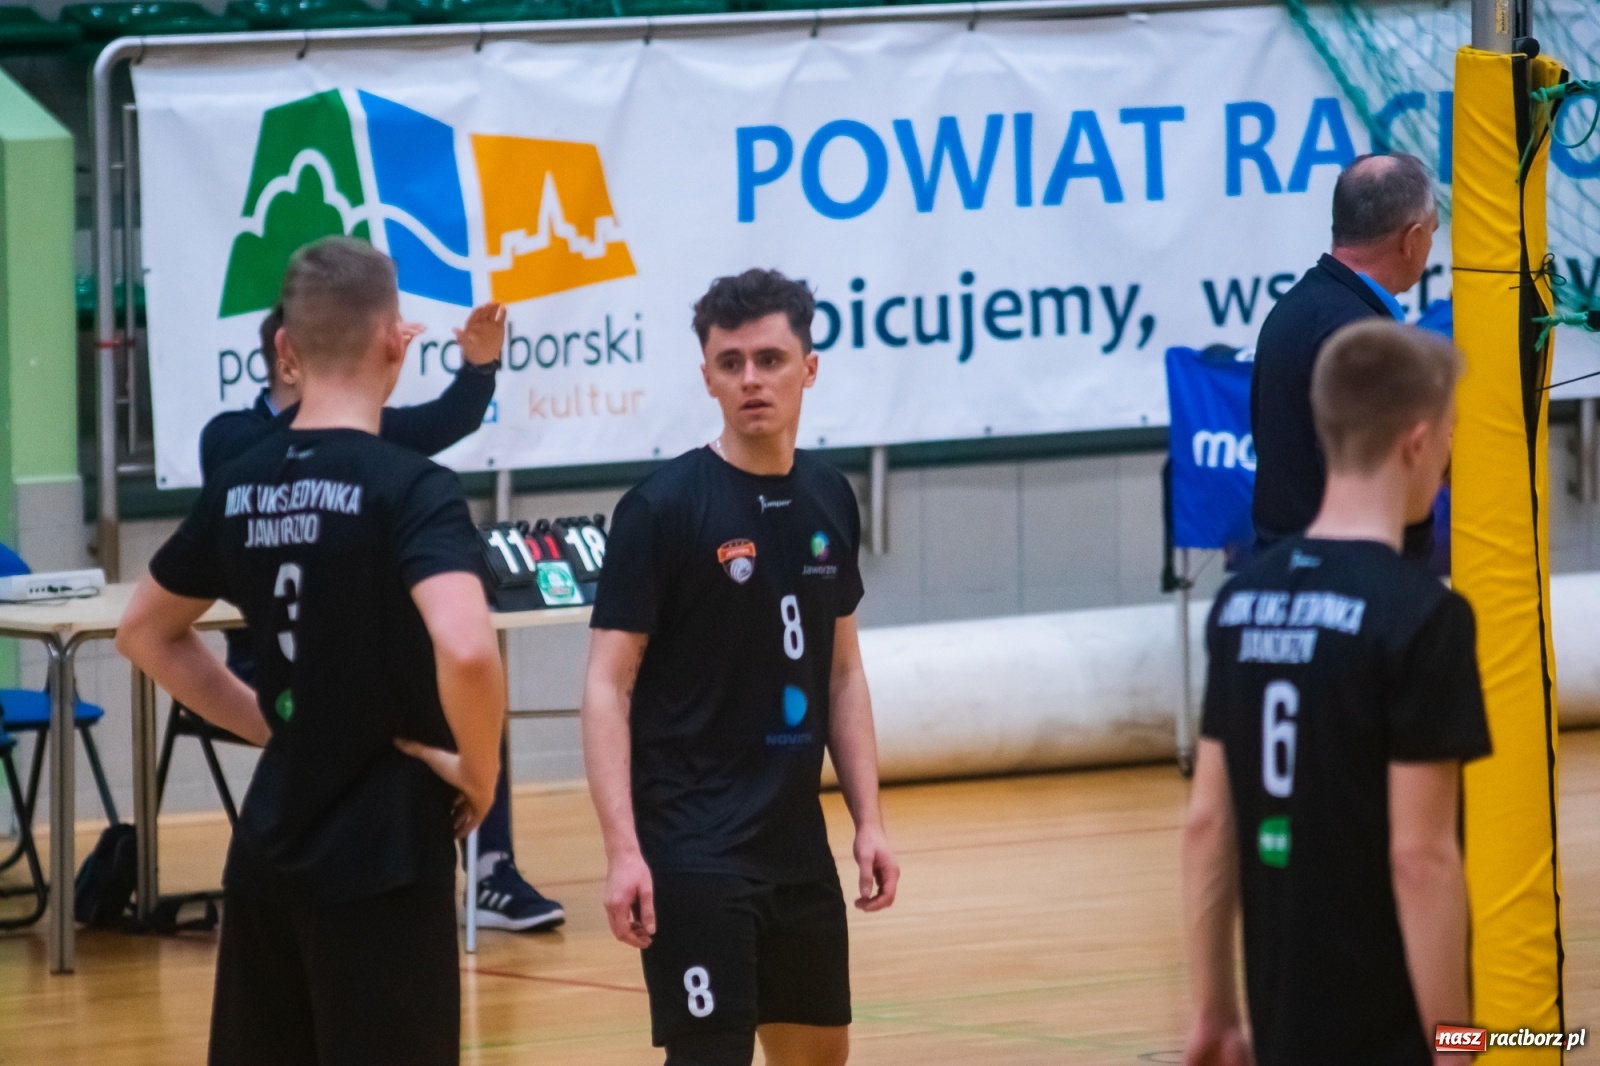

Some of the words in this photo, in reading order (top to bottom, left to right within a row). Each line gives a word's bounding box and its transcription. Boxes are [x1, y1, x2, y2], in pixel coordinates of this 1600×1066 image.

[736, 105, 1186, 223] POWIAT
[804, 270, 1155, 364] bicujemy,
[488, 529, 537, 575] 11
[780, 594, 806, 661] 8
[1262, 679, 1300, 799] 6
[683, 966, 715, 1018] 8
